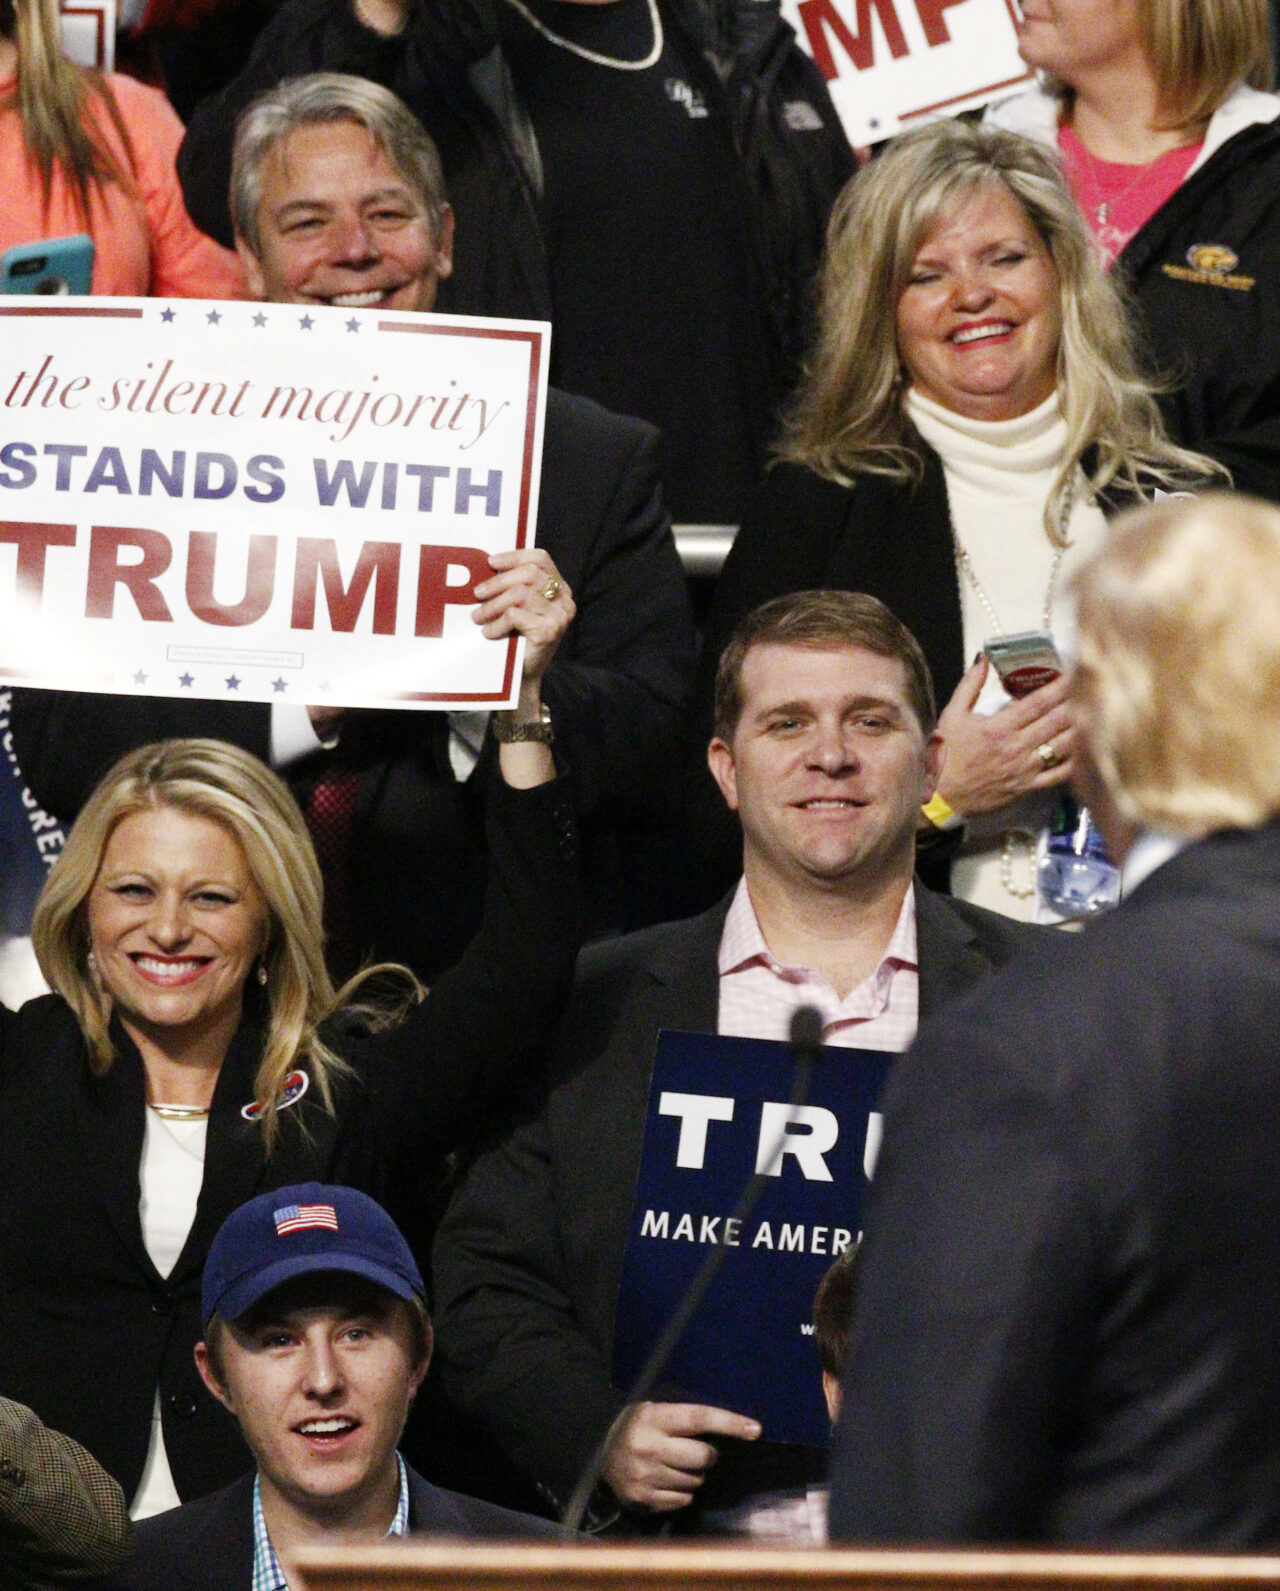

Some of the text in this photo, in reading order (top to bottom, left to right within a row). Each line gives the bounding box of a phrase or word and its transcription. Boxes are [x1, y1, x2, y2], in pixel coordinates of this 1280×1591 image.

[3, 354, 511, 450] the silent majority
[0, 441, 503, 518] STANDS WITH
[0, 520, 495, 638] TRUMP
[640, 1209, 742, 1247] MAKE
